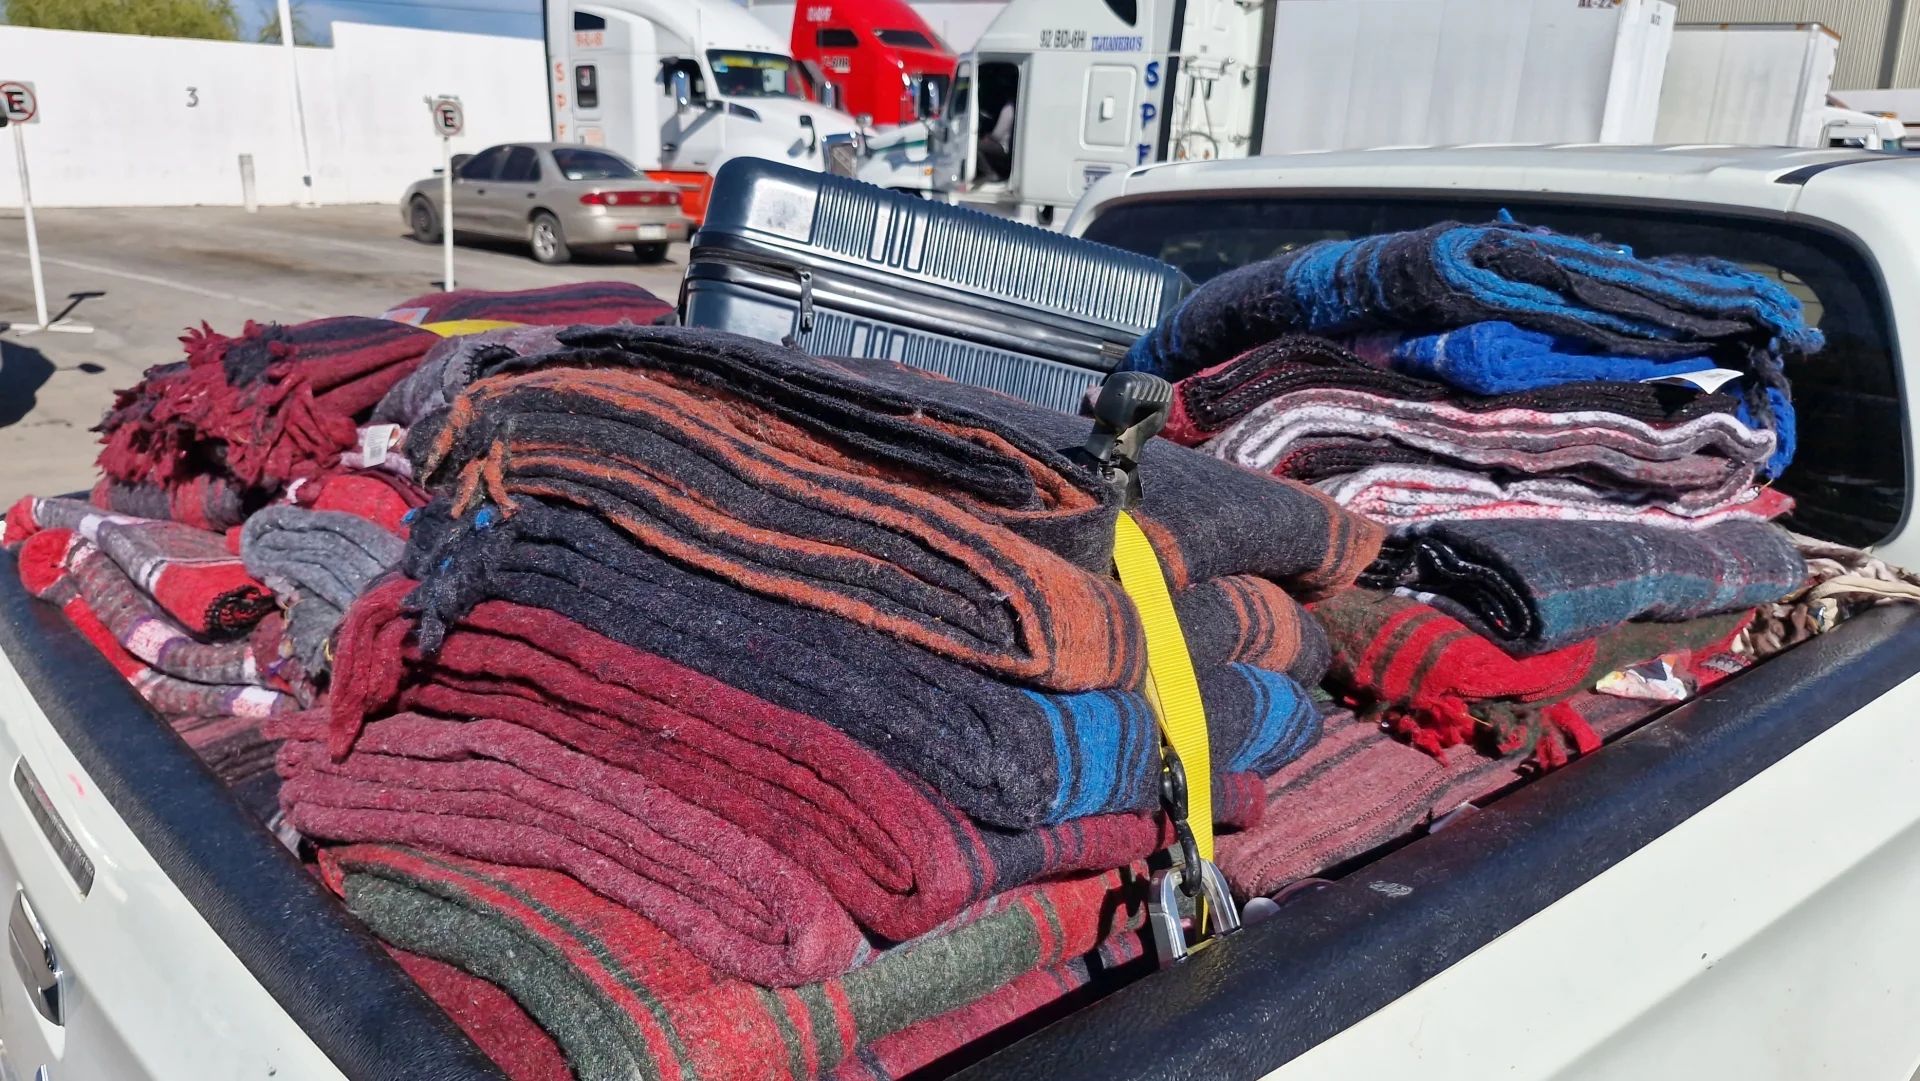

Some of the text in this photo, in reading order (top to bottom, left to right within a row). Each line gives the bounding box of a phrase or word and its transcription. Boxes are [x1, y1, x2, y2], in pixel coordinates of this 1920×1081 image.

[5, 91, 25, 113] E
[185, 86, 199, 108] 3
[443, 109, 455, 127] E
